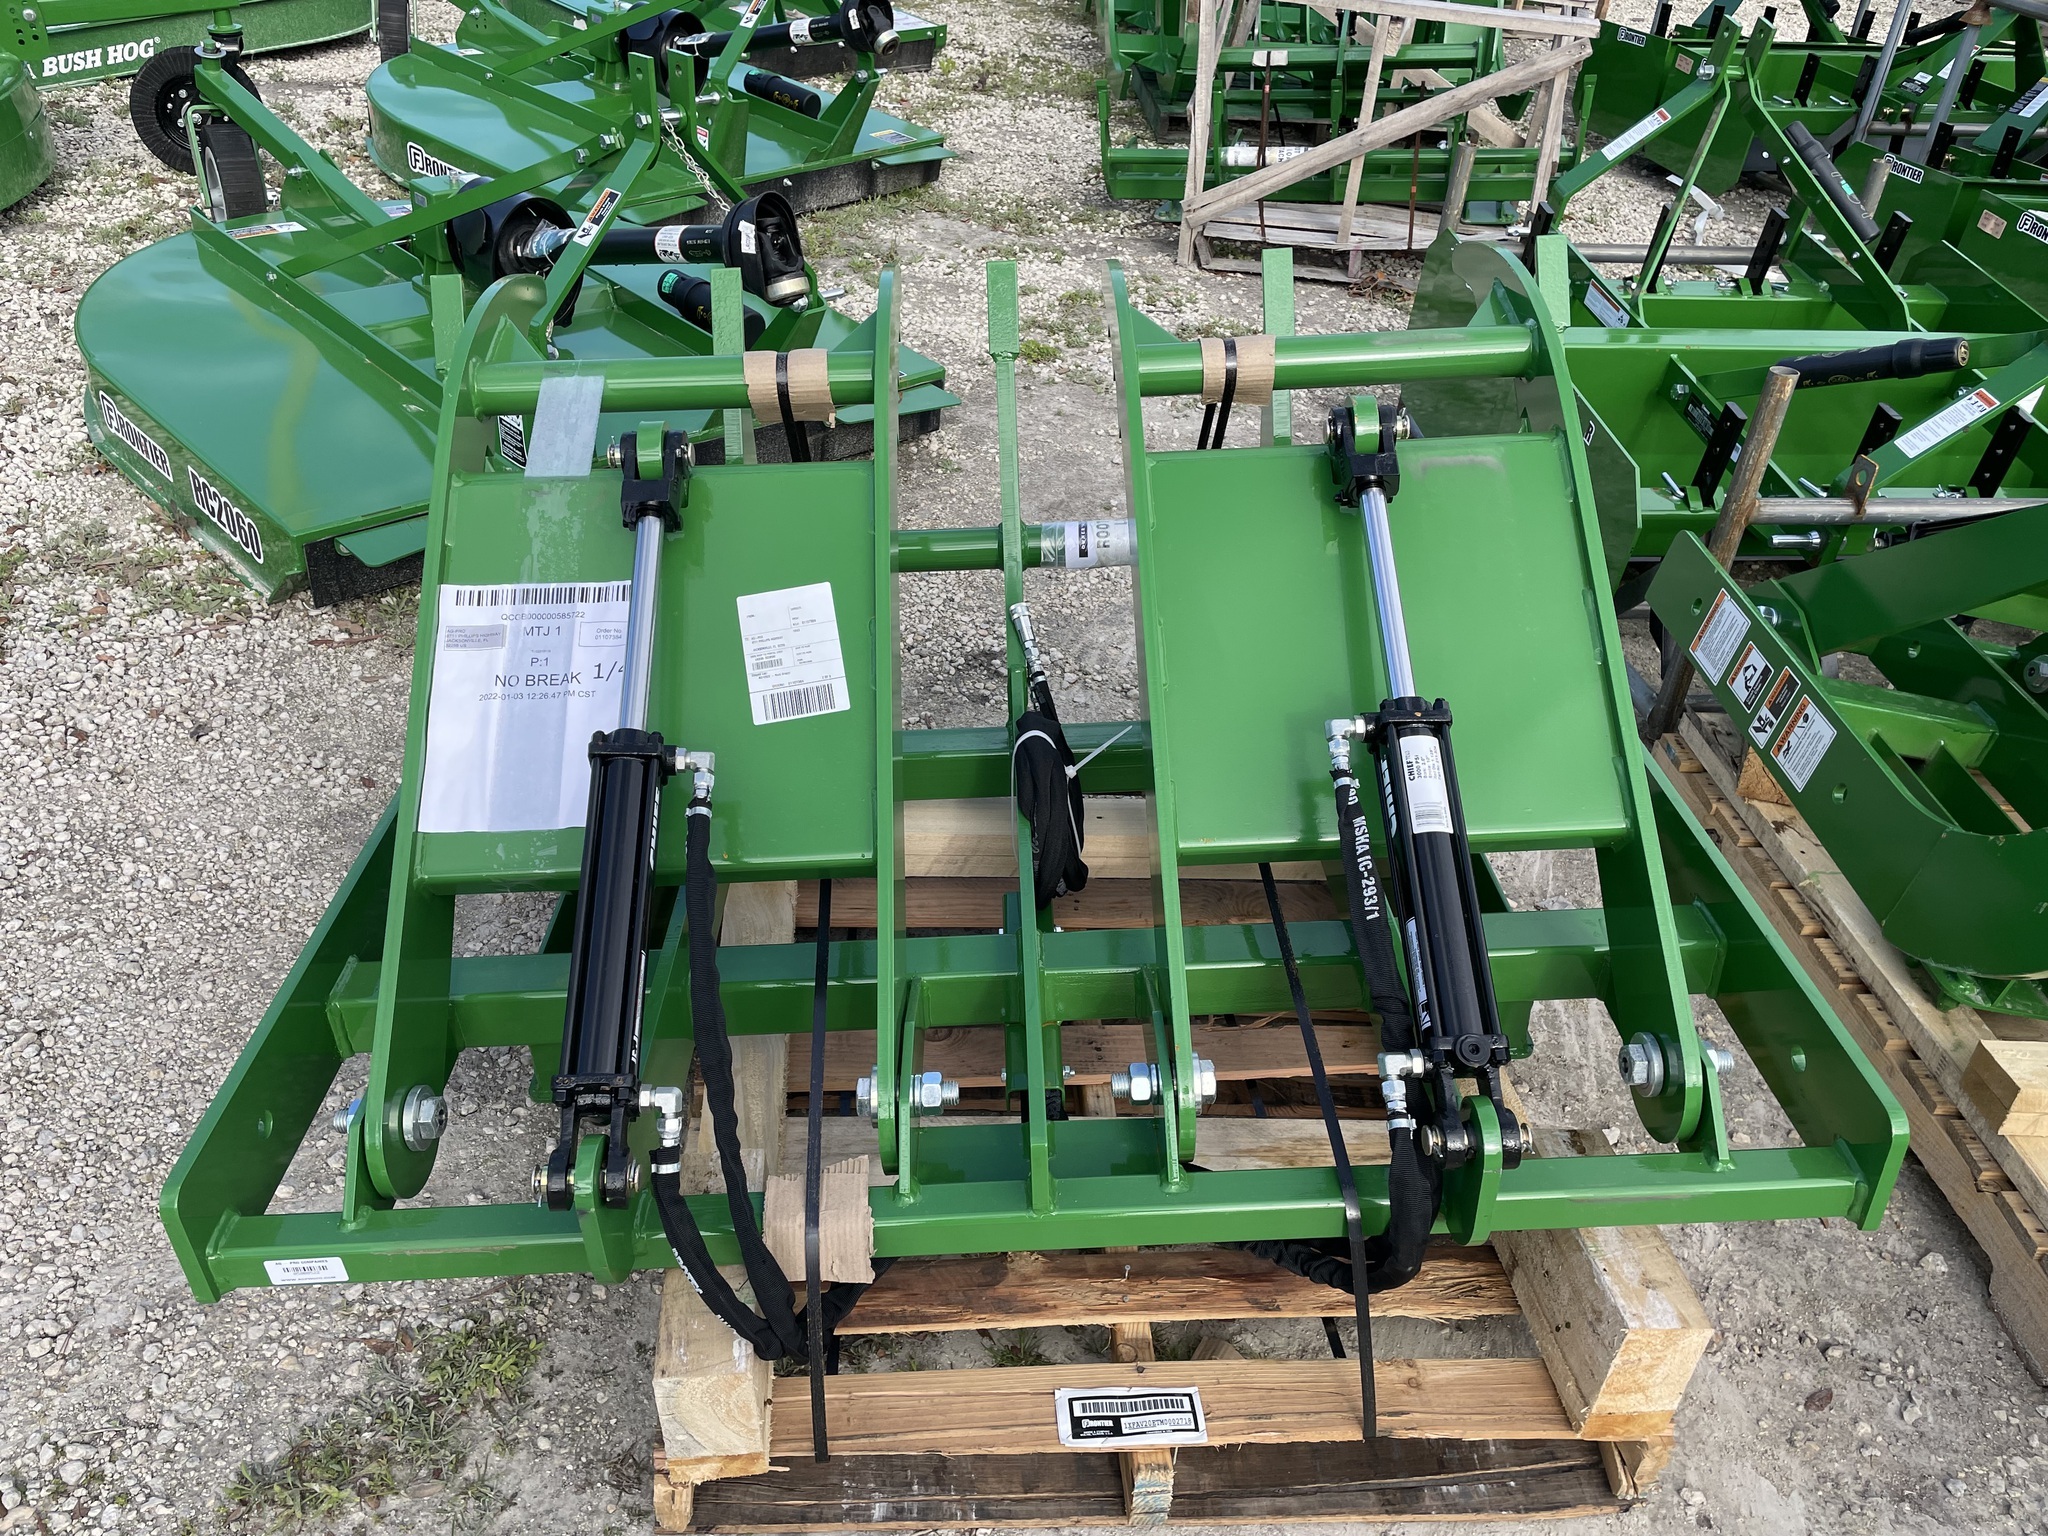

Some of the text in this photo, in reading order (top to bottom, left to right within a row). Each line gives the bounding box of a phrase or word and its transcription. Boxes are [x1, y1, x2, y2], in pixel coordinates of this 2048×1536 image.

[42, 48, 102, 77] BUSH
[1885, 155, 1923, 183] RONTIER
[100, 393, 172, 480] FRONTIER
[190, 470, 262, 560] RC2060
[523, 626, 561, 637] MTJ 1
[530, 657, 549, 667] P:1
[495, 671, 581, 688] NO BREAK
[479, 692, 524, 702] 2022-01-03
[563, 690, 576, 698] PM
[578, 690, 596, 699] CST
[1777, 703, 1807, 746] WARNING
[1406, 760, 1415, 781] CHIEF
[1352, 815, 1380, 921] MSHA IC-293/1
